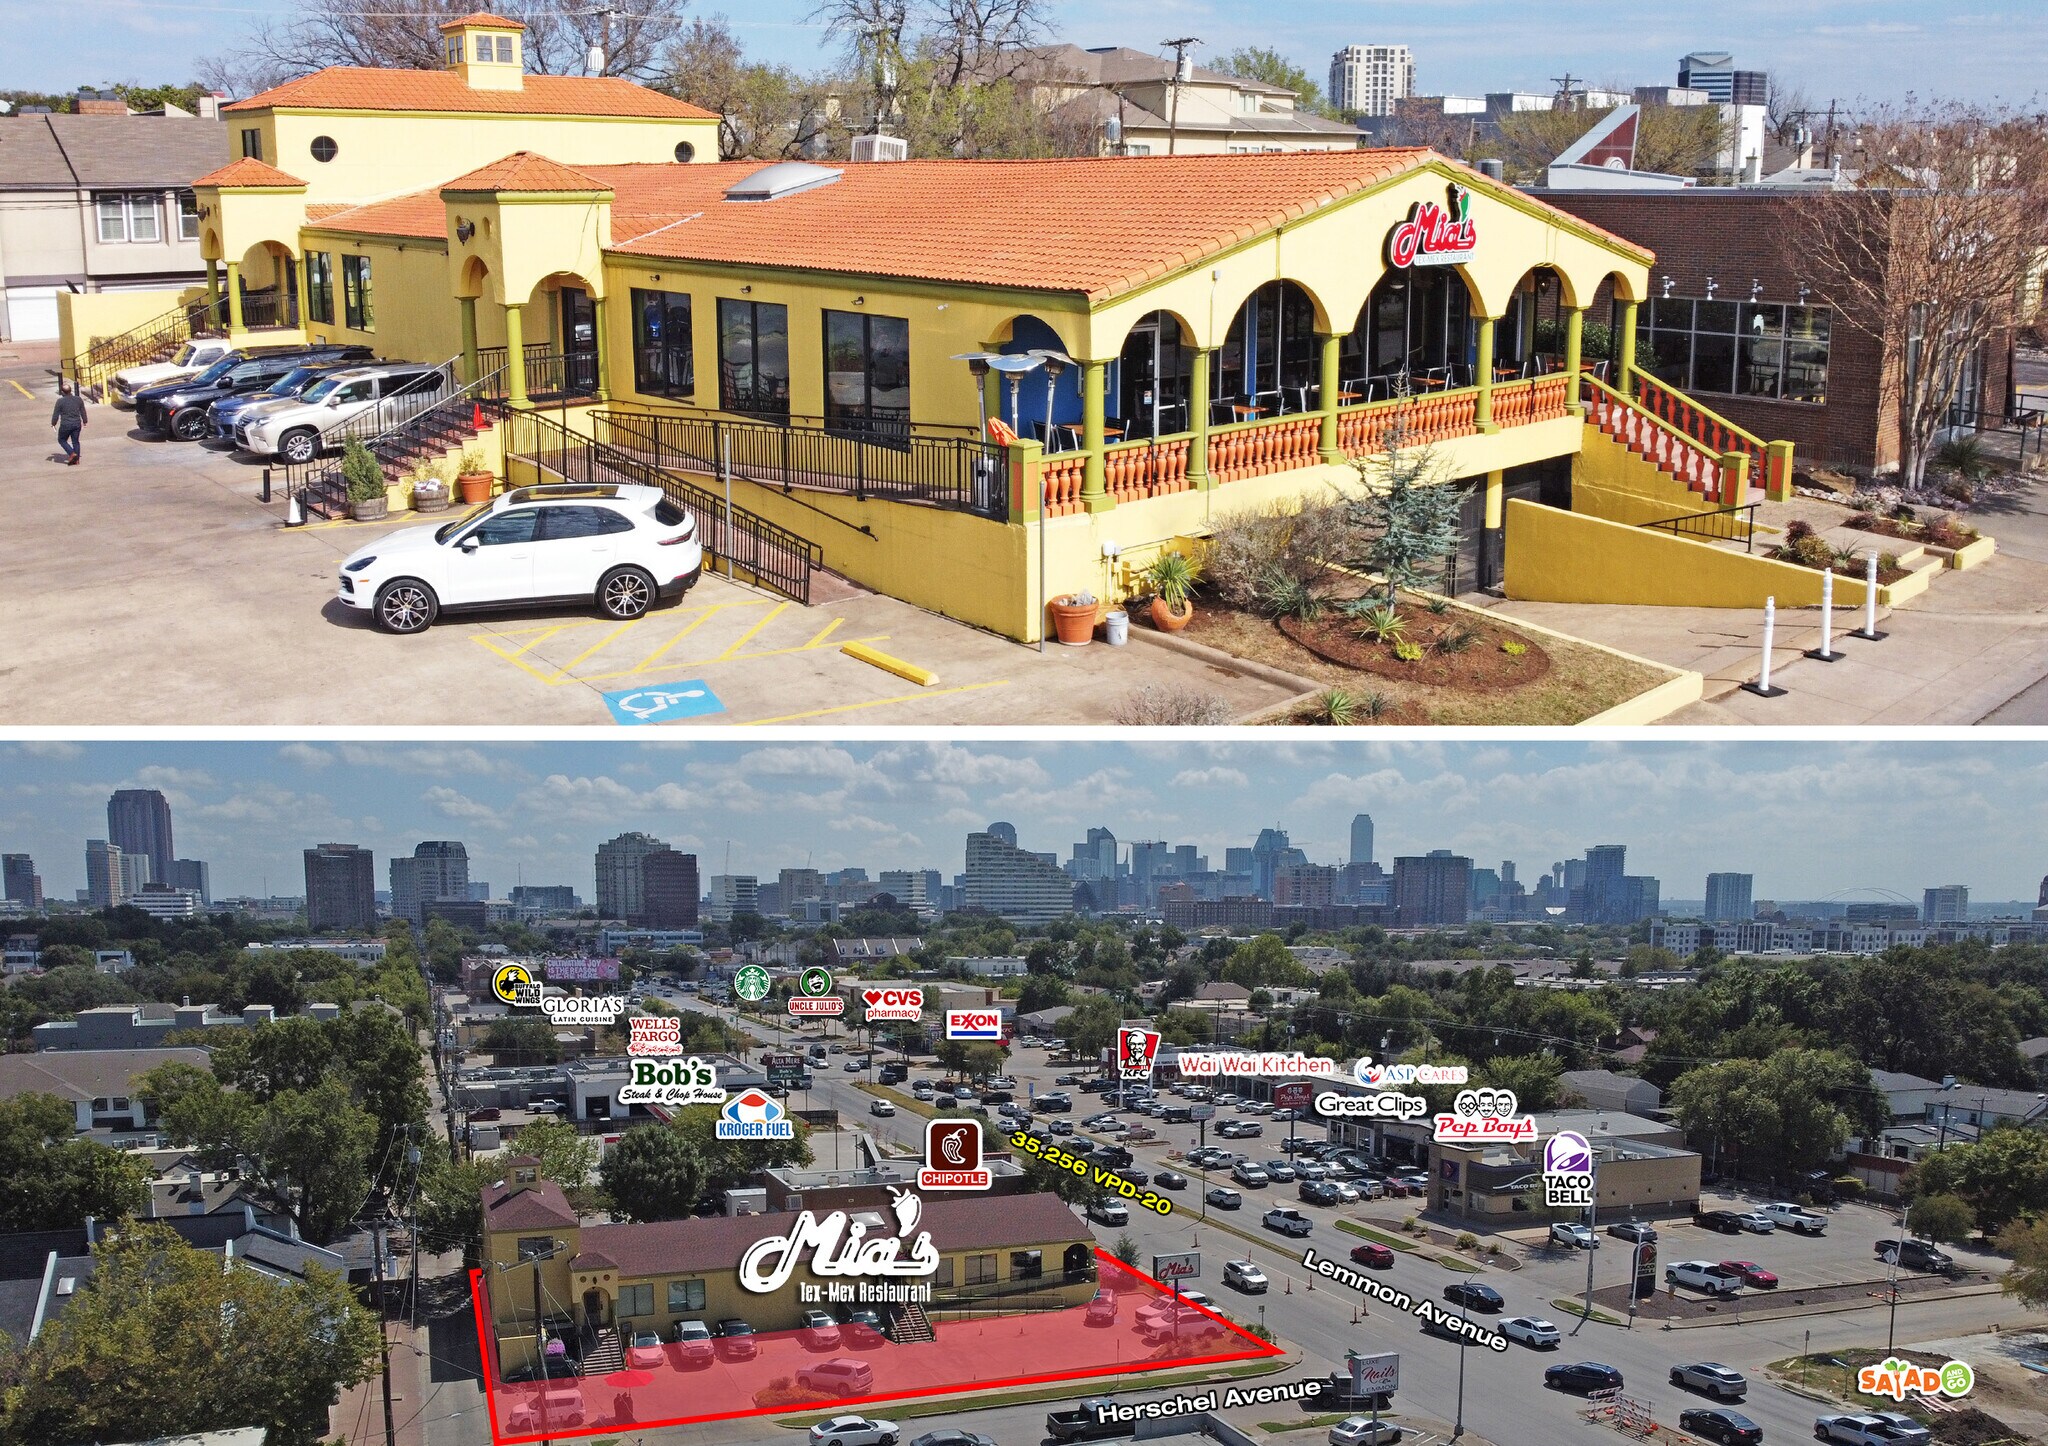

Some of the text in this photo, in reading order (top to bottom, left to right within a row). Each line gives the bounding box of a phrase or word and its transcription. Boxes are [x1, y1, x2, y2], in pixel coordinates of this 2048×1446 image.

[1391, 184, 1477, 268] Mia's
[588, 960, 601, 968] JOY
[1361, 1365, 1395, 1384] Nails
[1362, 1384, 1397, 1394] LEMMON
